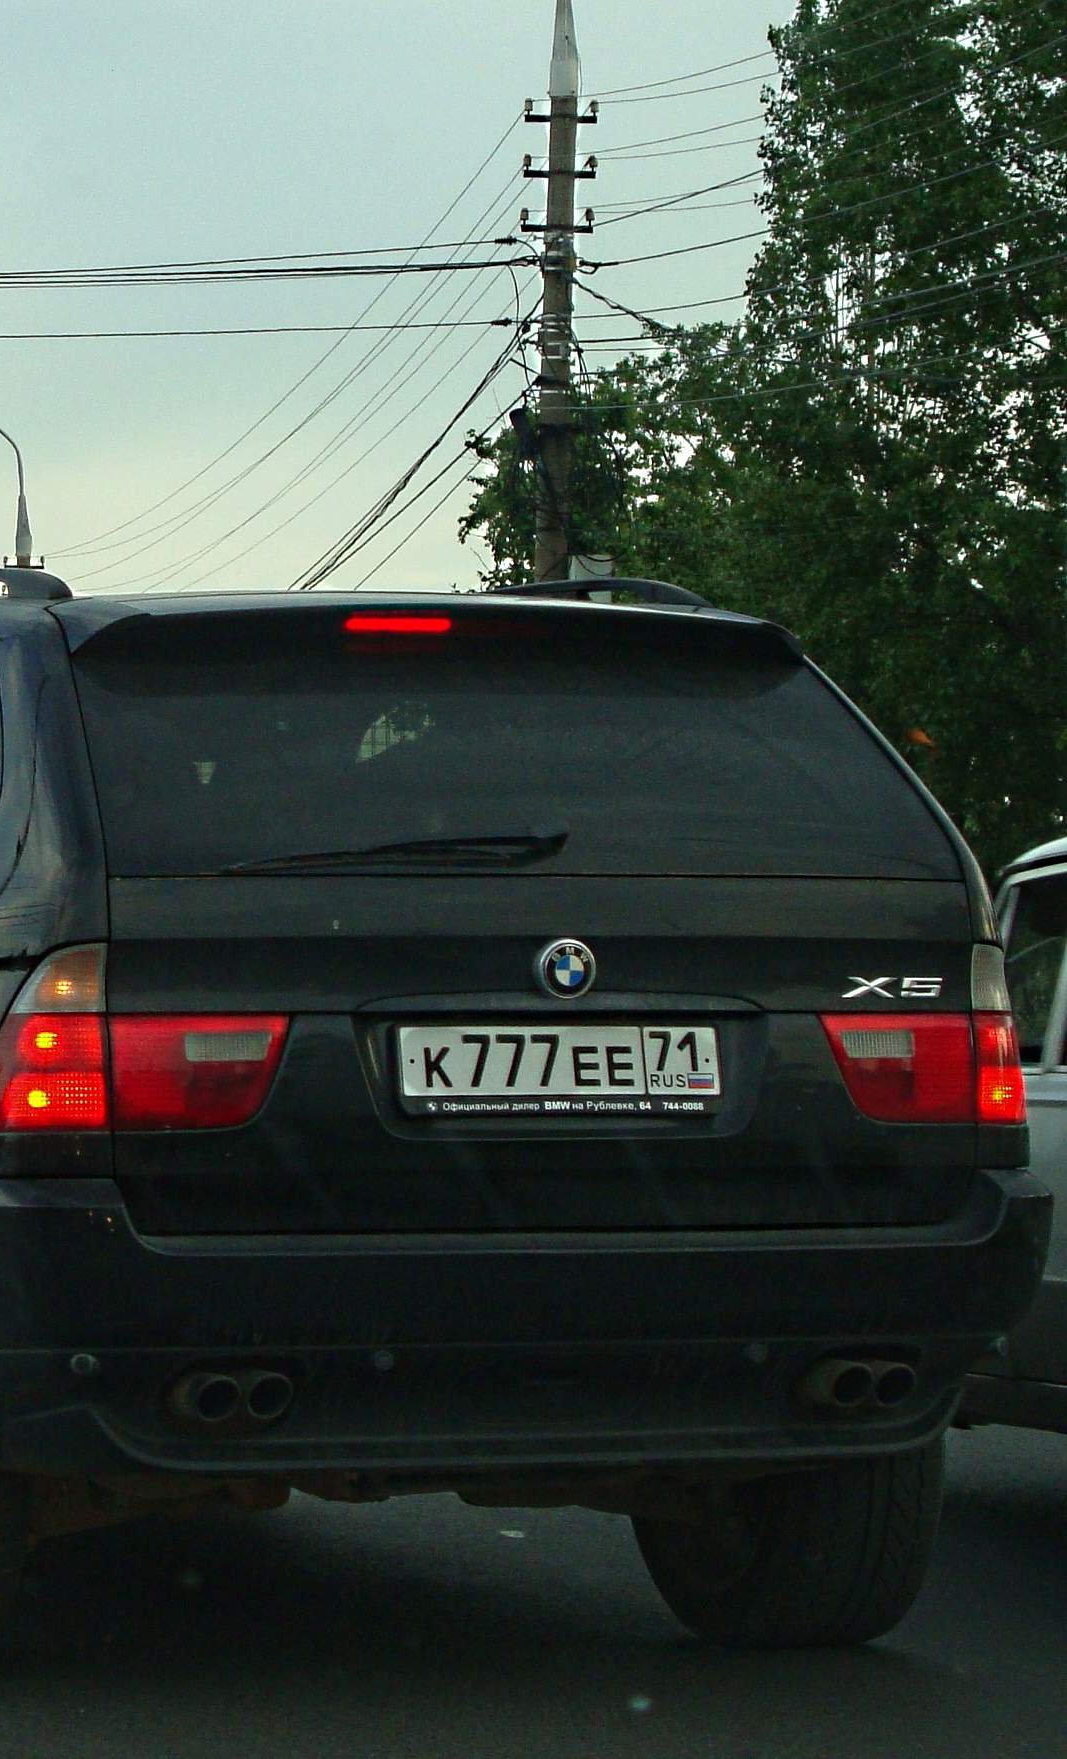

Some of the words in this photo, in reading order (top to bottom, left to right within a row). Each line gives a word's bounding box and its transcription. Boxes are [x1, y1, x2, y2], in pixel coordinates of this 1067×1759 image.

[841, 976, 943, 998] X5
[648, 1031, 700, 1072] 71
[650, 1073, 686, 1088] RUS
[544, 1101, 570, 1110] BMW
[639, 1101, 651, 1110] 64
[662, 1101, 704, 1111] 744-0088
